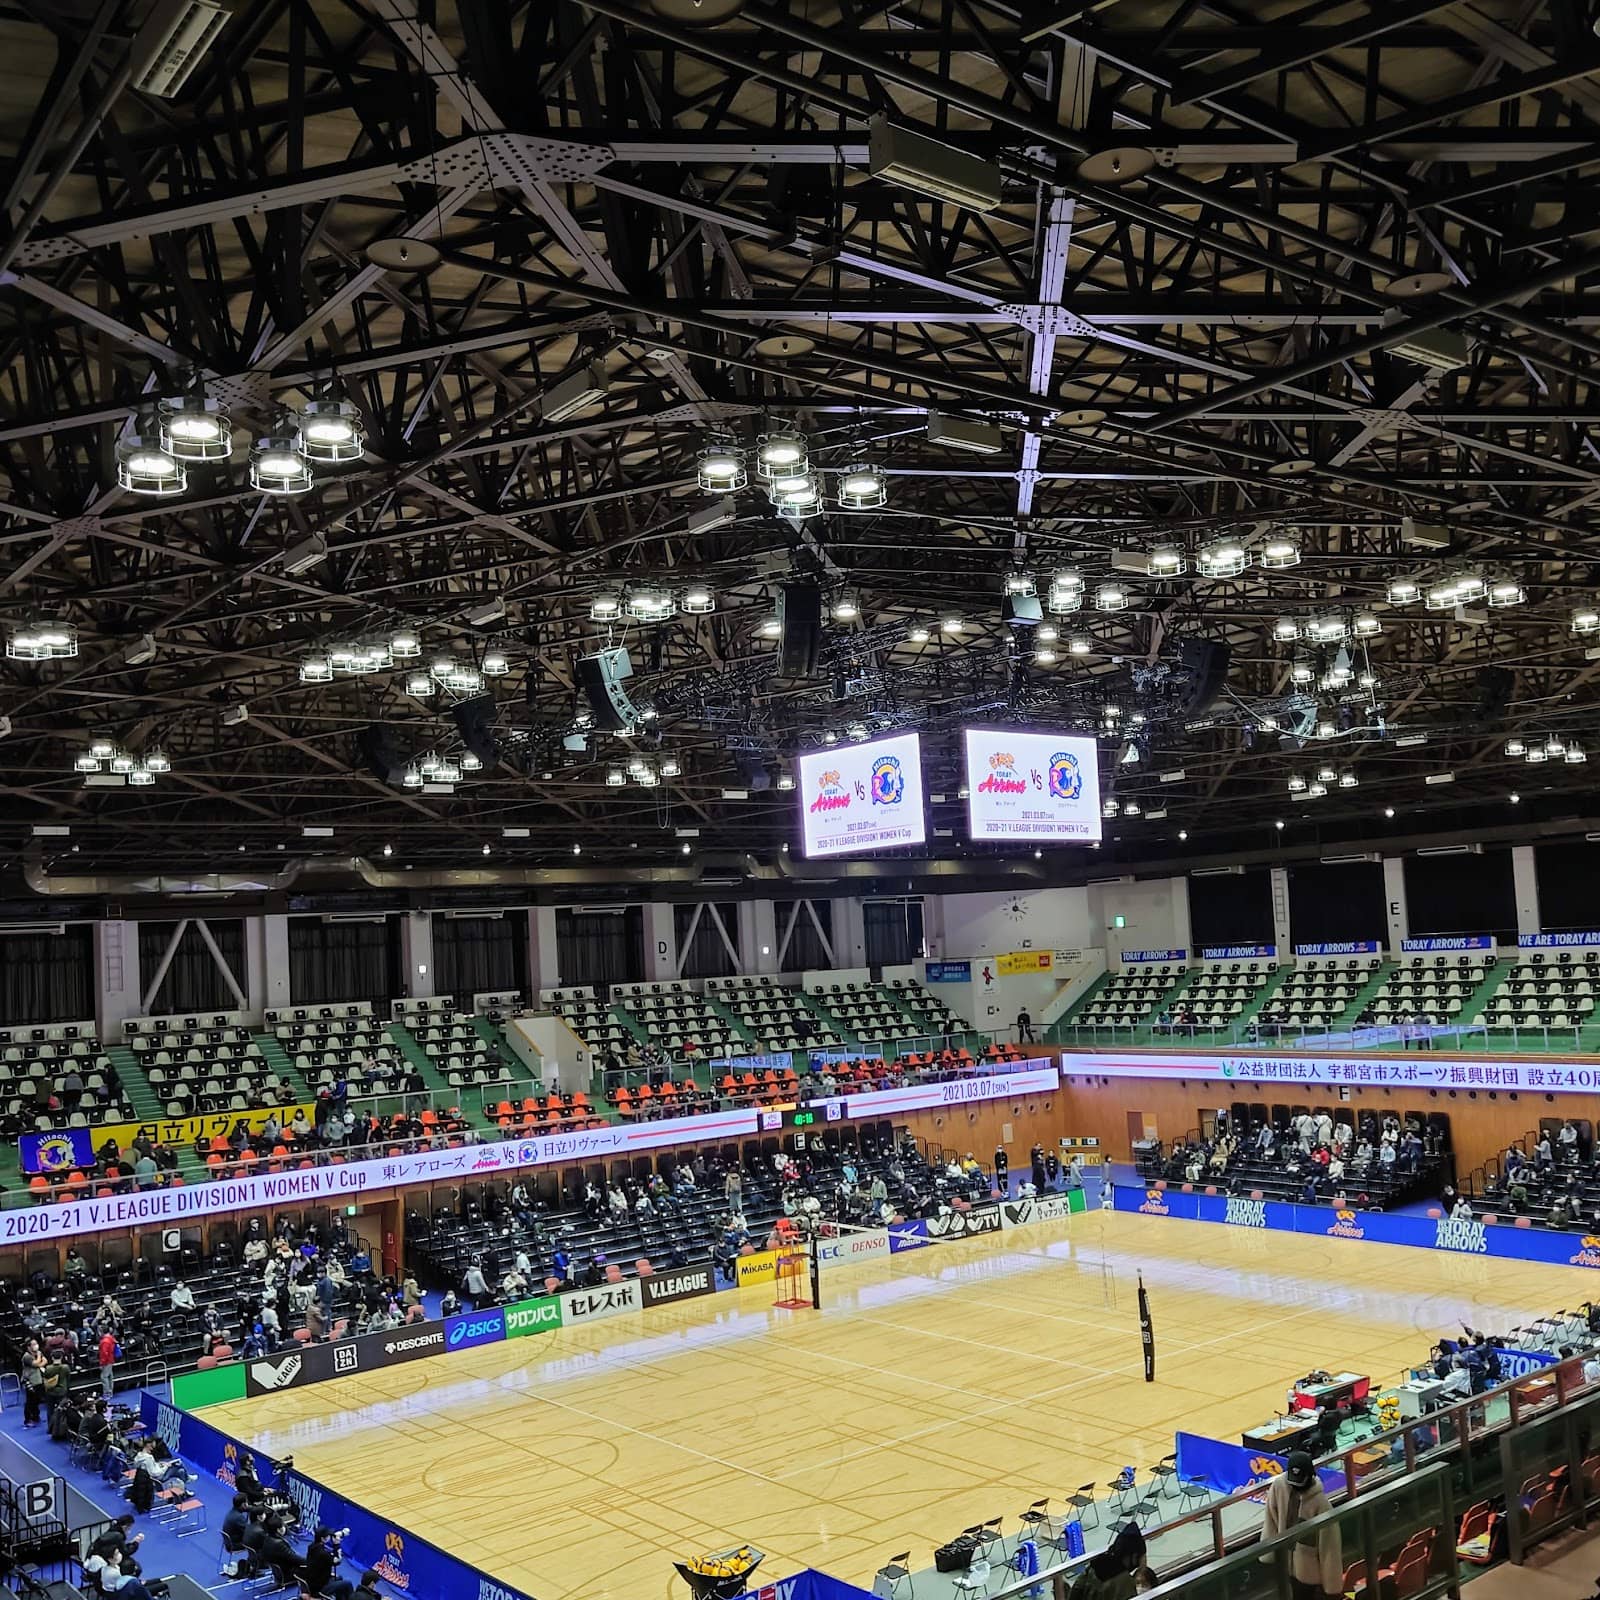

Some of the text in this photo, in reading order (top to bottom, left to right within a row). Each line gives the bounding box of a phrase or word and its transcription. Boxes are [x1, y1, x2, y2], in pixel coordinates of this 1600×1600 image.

[1390, 902, 1400, 915] E
[658, 942, 667, 954] D
[1403, 937, 1466, 949] TORAY ARROWS
[1518, 935, 1532, 946] WE
[1535, 935, 1552, 945] ARE
[1555, 933, 1584, 944] TORAY
[1122, 951, 1168, 961] TORAY ARROWS
[1205, 947, 1255, 958] TORAY ARROWS
[1299, 943, 1355, 954] TORAY ARROWS
[1239, 1062, 1320, 1078] 公益財団法人
[1328, 1063, 1519, 1085] 宇都宮市スポーツ振興財団
[1339, 1086, 1349, 1099] F
[37, 1134, 72, 1146] Hitachi
[544, 1134, 623, 1157] 日立リヴァーレ
[6, 1208, 80, 1236] 2020-21
[90, 1195, 171, 1224] V.LEAGUE
[178, 1182, 256, 1211] DIVISION1
[264, 1174, 320, 1198] WOMEN
[326, 1172, 335, 1189] V
[340, 1170, 366, 1188] Cup
[1235, 1199, 1266, 1213] TORAY
[1224, 1210, 1266, 1227] ARROWS
[1447, 1220, 1485, 1237] TORAY
[164, 1230, 178, 1249] C
[852, 1238, 885, 1252] DENSO
[1436, 1234, 1487, 1252] ARROWS
[649, 1272, 708, 1299] V.LEAGUE
[569, 1286, 633, 1316] セレスポ
[507, 1305, 559, 1329] サロンパス
[467, 1319, 500, 1338] asics
[396, 1333, 444, 1351] DESCENTE
[273, 1356, 301, 1387] LEAGUE
[26, 1482, 53, 1516] B
[295, 1480, 322, 1515] TORAY
